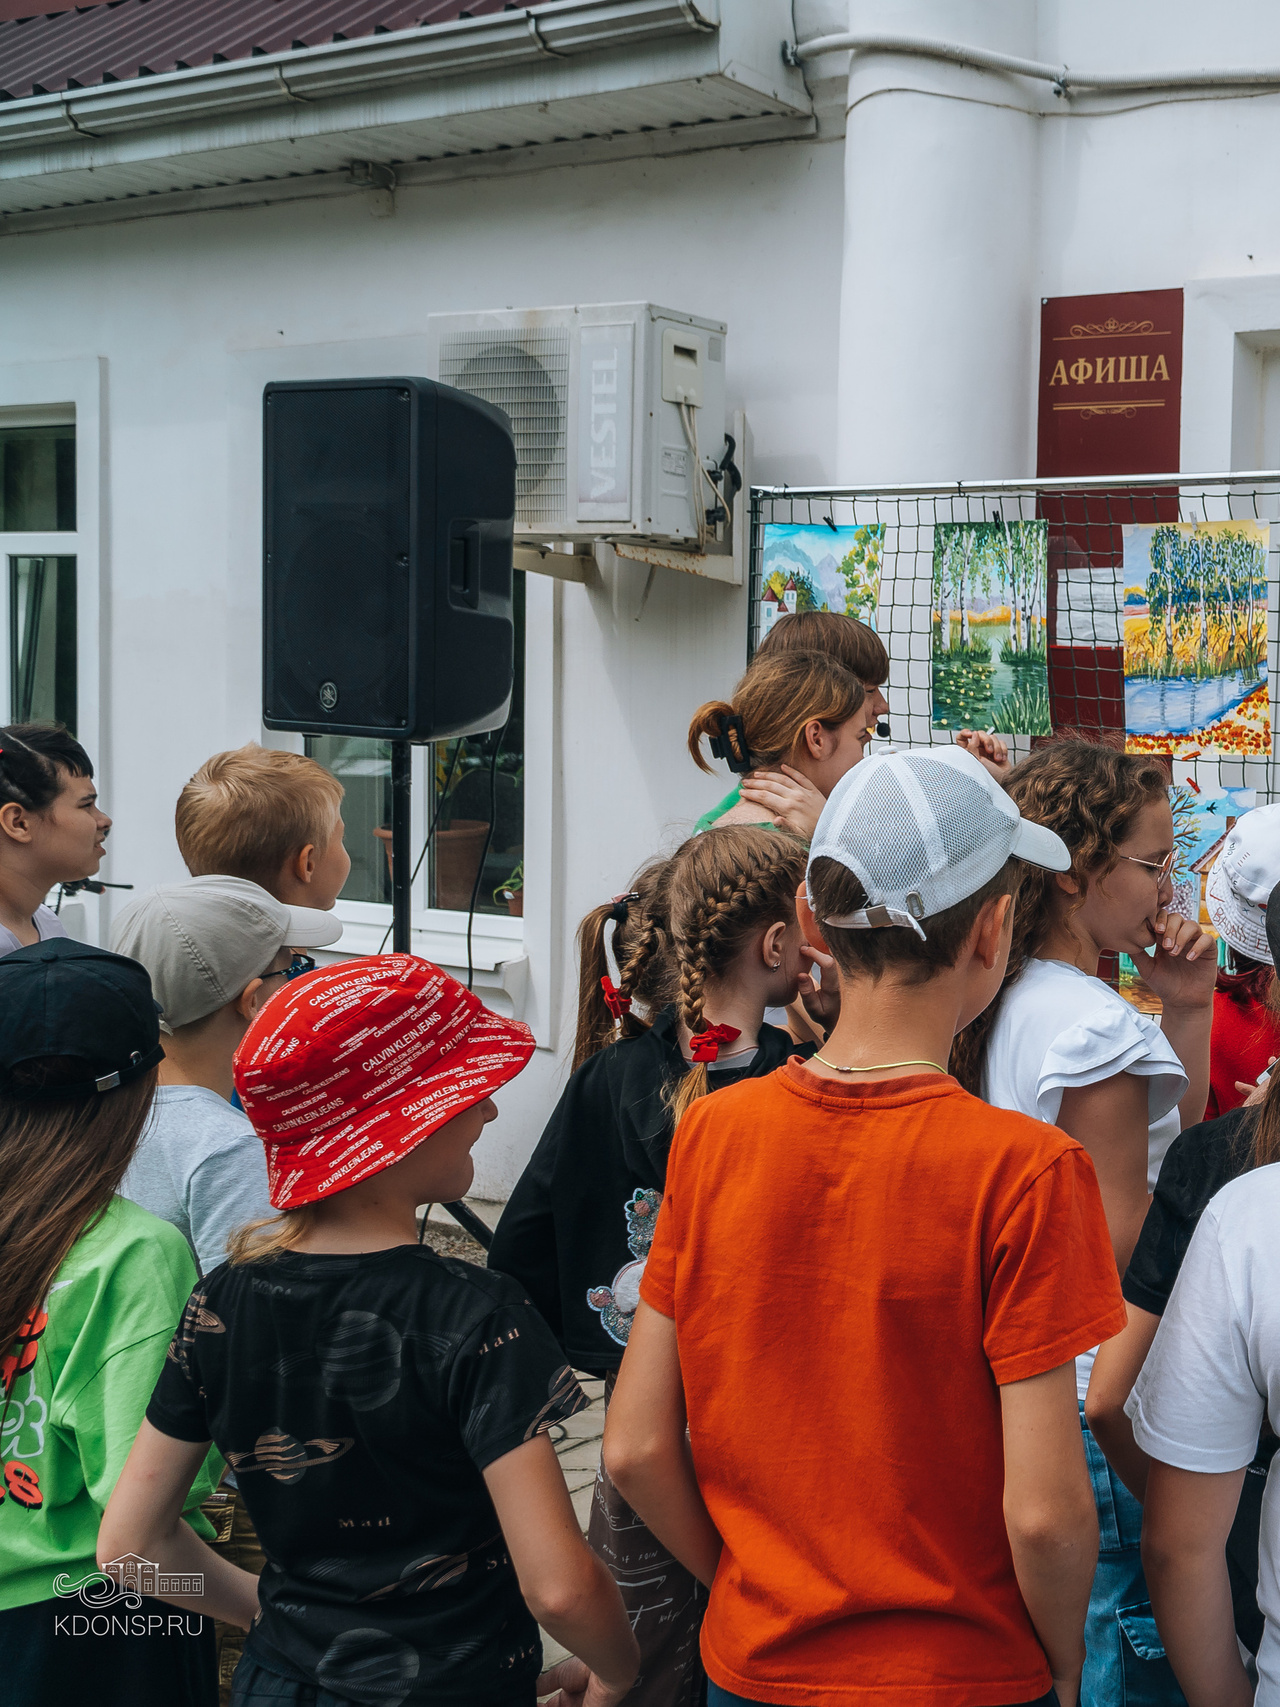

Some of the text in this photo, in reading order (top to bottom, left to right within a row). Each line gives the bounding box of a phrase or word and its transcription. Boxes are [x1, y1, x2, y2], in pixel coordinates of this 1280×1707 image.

[1049, 354, 1170, 386] АФИША
[591, 348, 617, 499] VESTEL
[309, 984, 344, 1006] CALVIN
[342, 975, 371, 989] KLEIN
[372, 969, 402, 981] JEANS
[362, 1045, 396, 1071] CALVIN
[393, 1028, 420, 1051] KLEIN
[417, 1011, 441, 1035] JEANS
[272, 1097, 344, 1132] CALVIN KLEIN JEANS
[401, 1094, 434, 1117] CALVIN
[431, 1084, 460, 1099] KLEIN
[459, 1075, 488, 1090] JEANS
[317, 1169, 343, 1192] CALVIN
[339, 1155, 362, 1176] KLEIN
[359, 1140, 384, 1162] JEANS
